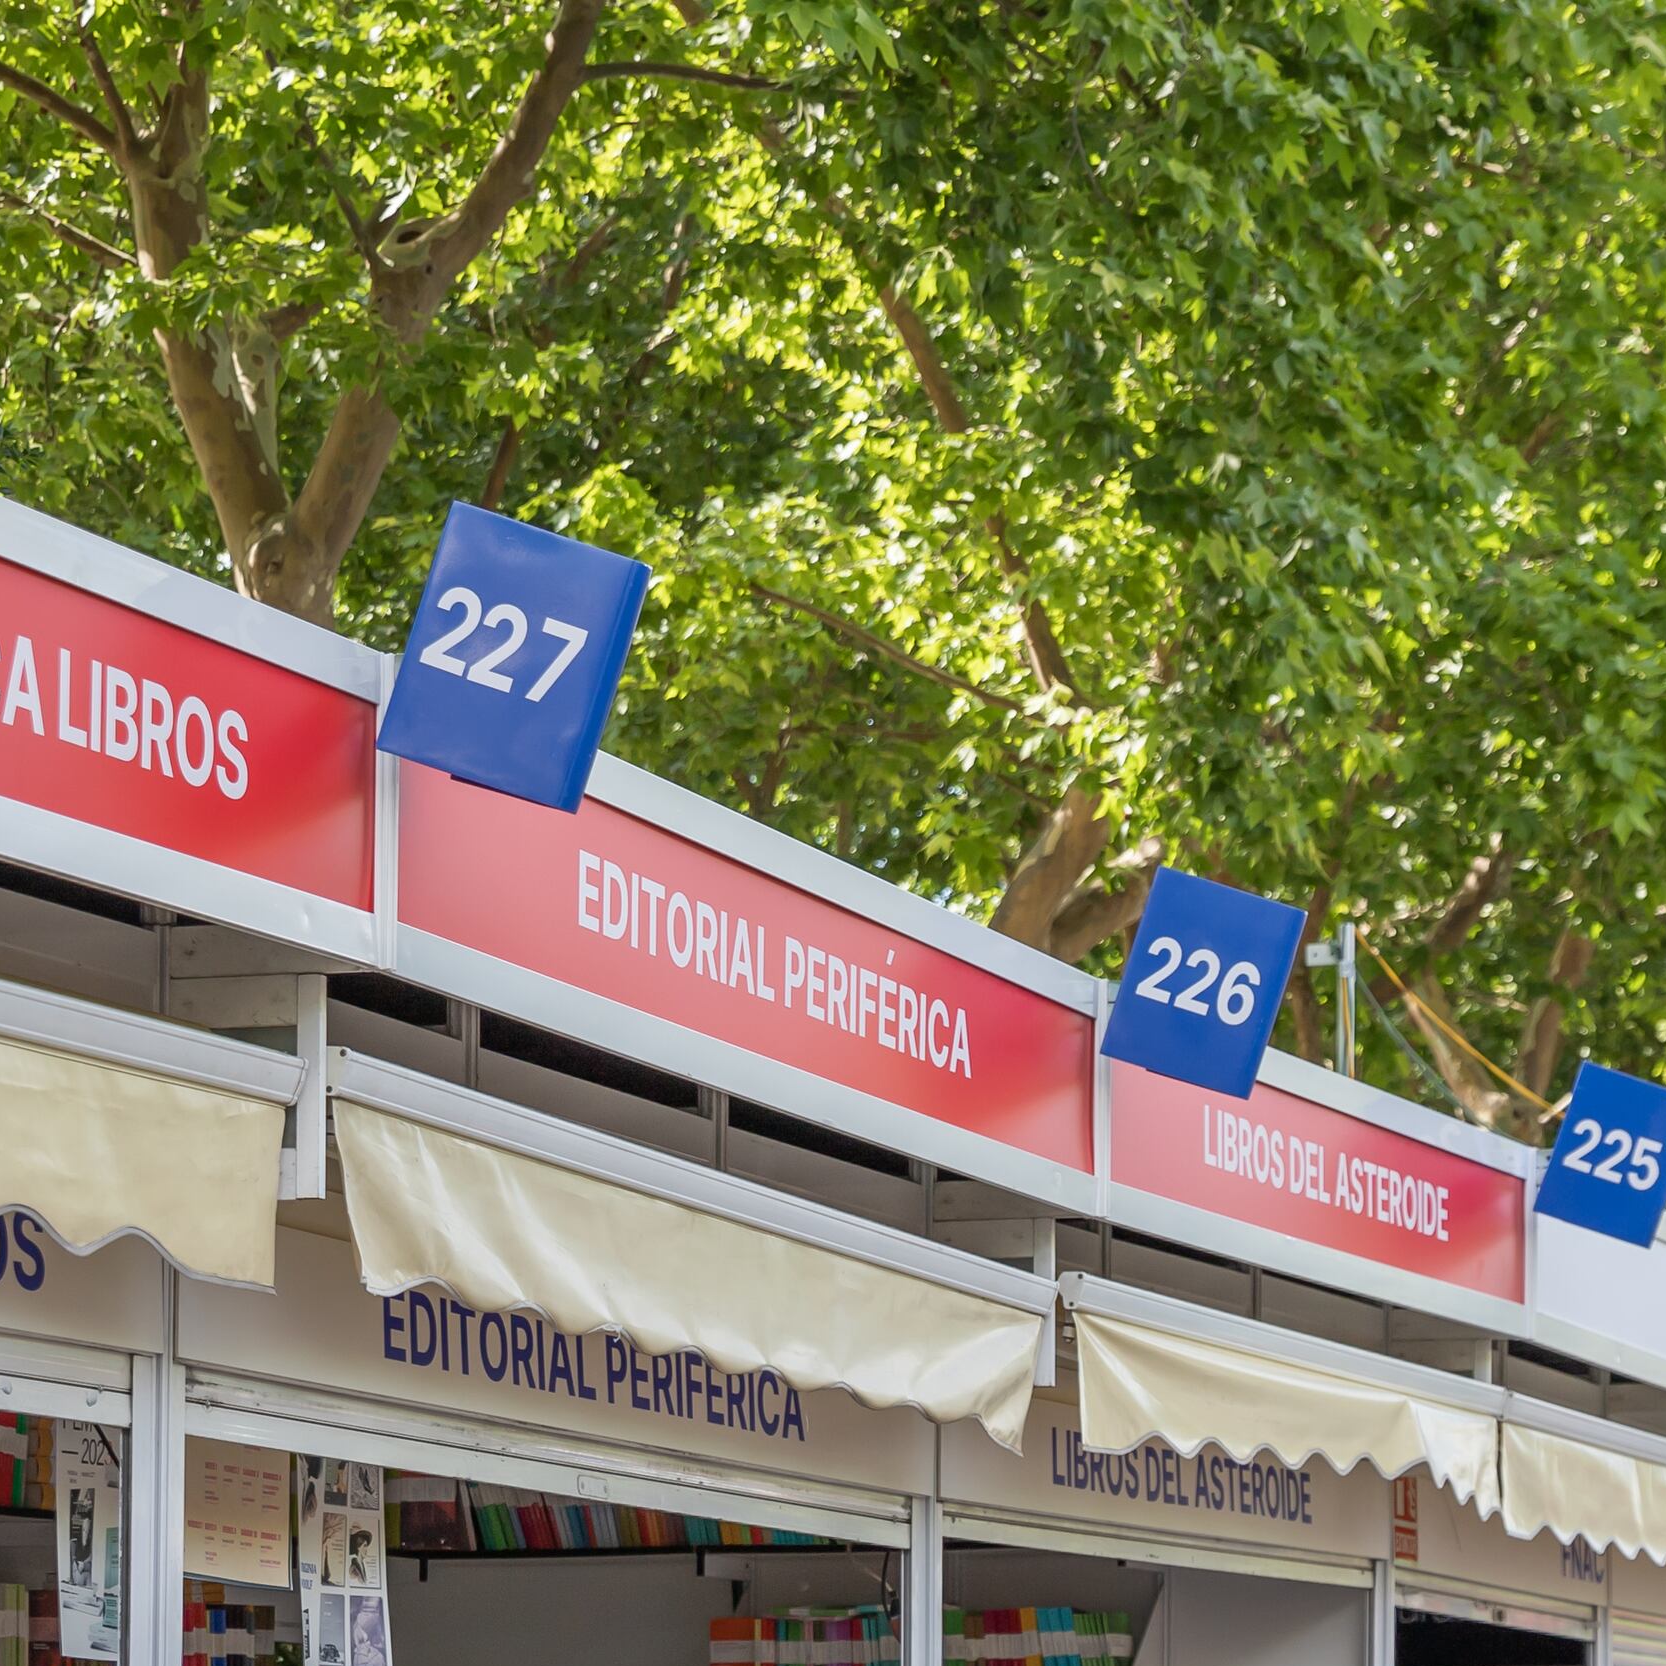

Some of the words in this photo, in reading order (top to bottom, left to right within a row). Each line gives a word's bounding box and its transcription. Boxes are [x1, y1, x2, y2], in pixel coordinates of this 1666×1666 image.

[419, 586, 589, 703] 227
[58, 648, 250, 801] LIBROS
[578, 849, 776, 1002] EDITORIAL
[783, 935, 973, 1079] PERIFÉRICA
[1135, 936, 1262, 1026] 226
[1202, 1104, 1286, 1190] LIBROS
[1290, 1134, 1332, 1205] DEL
[1336, 1147, 1450, 1242] ASTEROIDE
[1561, 1119, 1664, 1191] 225
[383, 1292, 597, 1401] EDITORIAL
[1051, 1426, 1141, 1500] LIBROS
[1144, 1445, 1190, 1507] DEL
[1195, 1453, 1313, 1525] ASTEROIDE
[1561, 1536, 1605, 1584] FNAC
